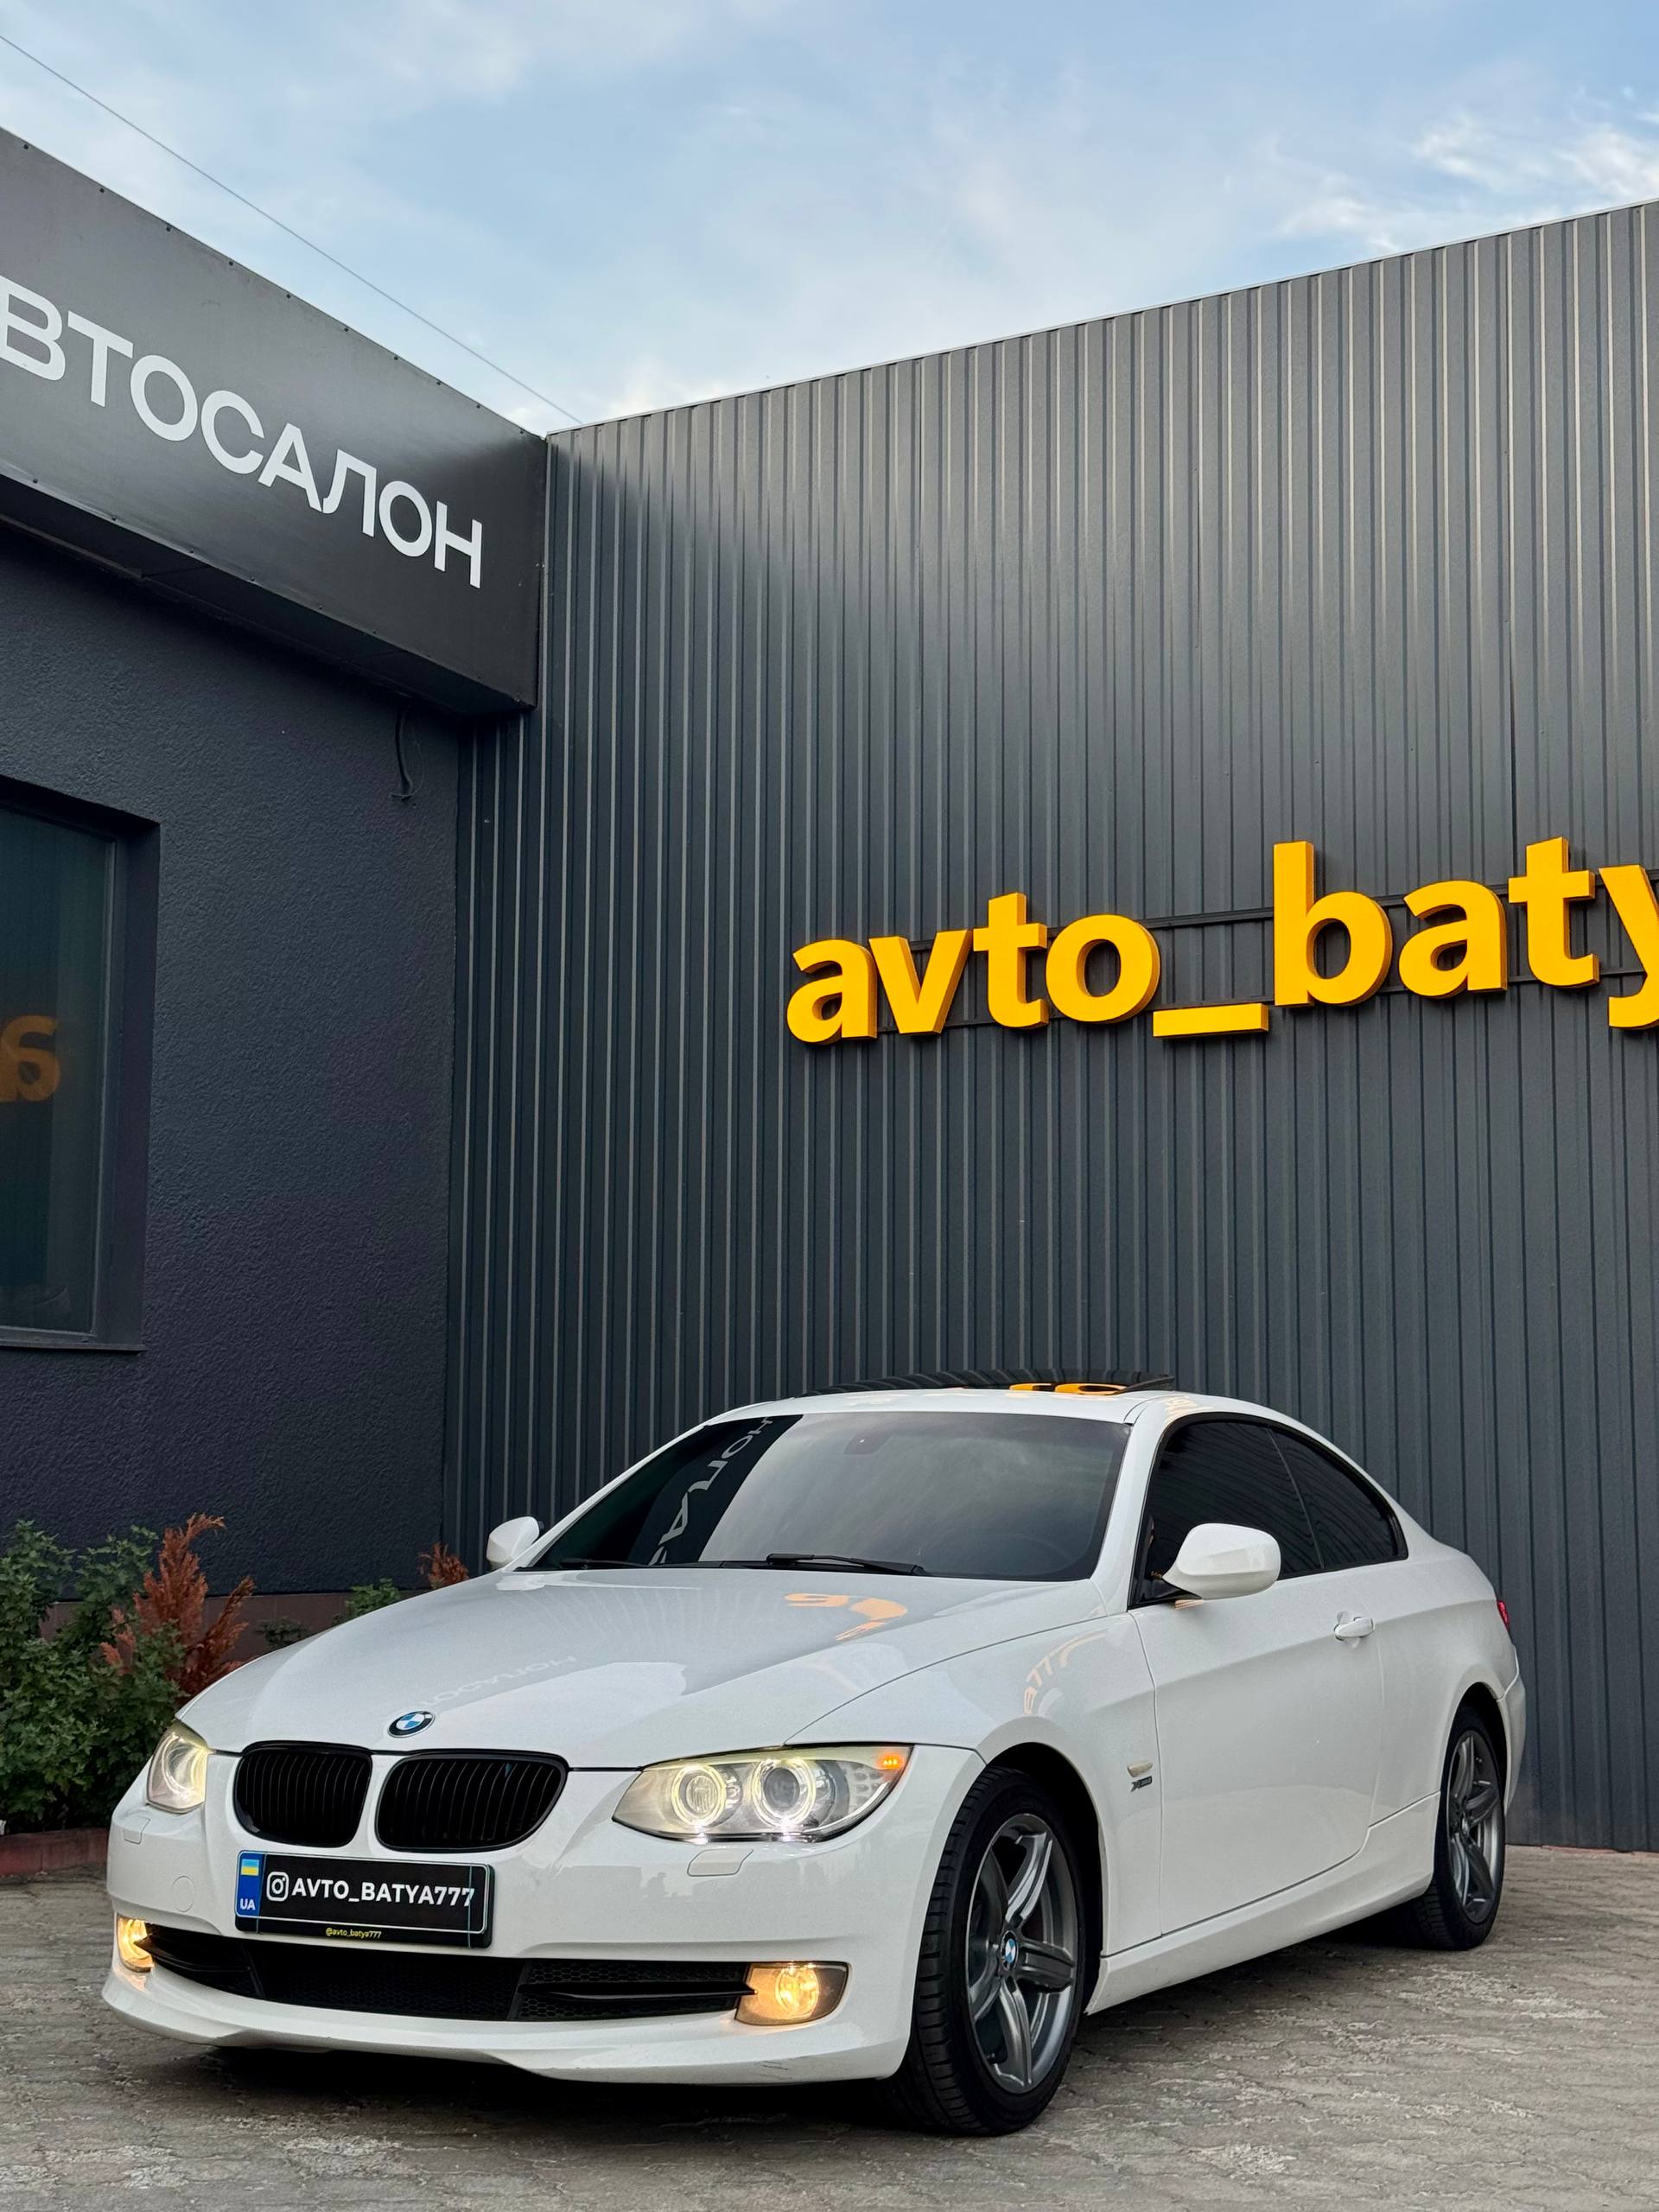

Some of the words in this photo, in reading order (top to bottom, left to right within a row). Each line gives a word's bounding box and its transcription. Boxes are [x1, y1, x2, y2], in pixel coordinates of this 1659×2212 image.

[291, 1878, 474, 1907] AVTO_BATYA777
[239, 1897, 256, 1910] UA
[325, 1927, 382, 1939] @avto_batya777
